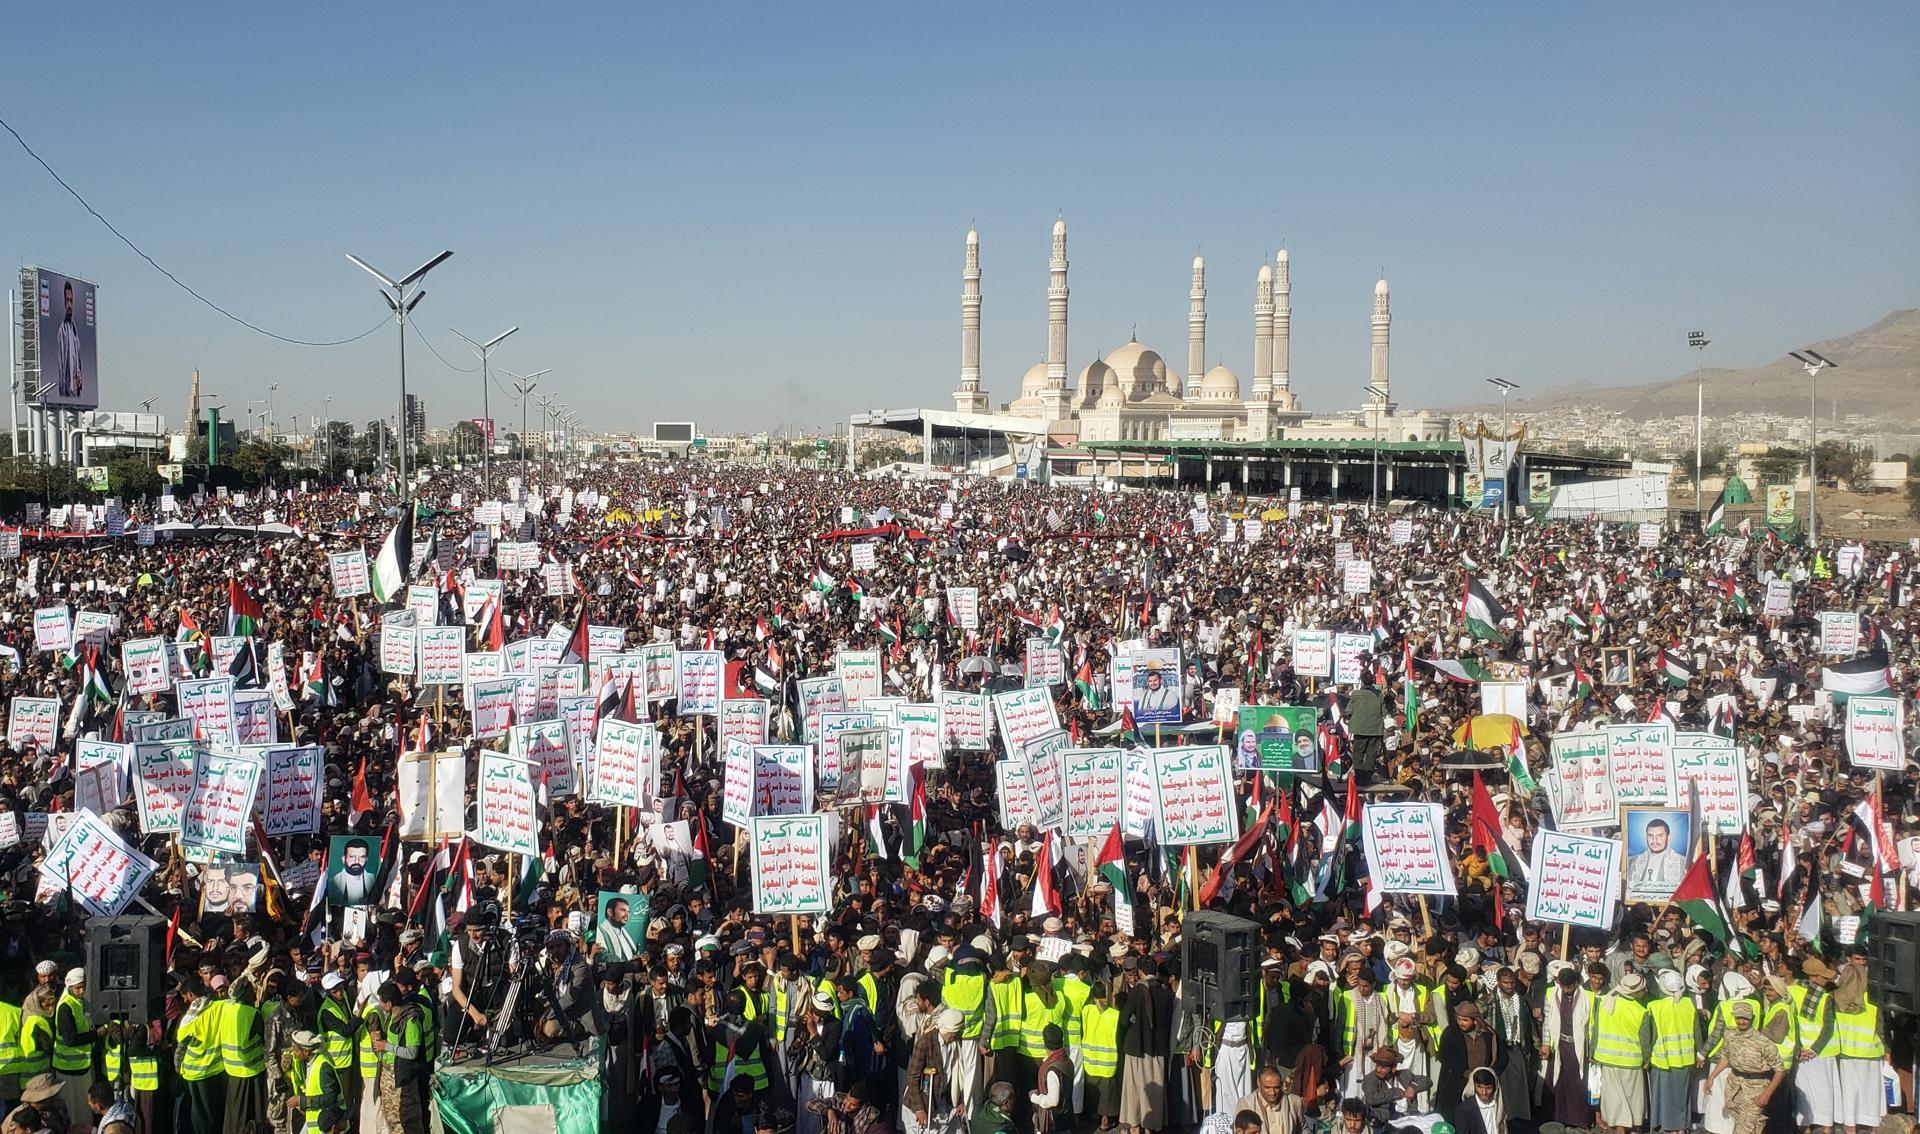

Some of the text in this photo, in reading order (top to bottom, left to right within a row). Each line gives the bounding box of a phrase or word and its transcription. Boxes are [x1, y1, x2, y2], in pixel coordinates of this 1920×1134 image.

[447, 631, 459, 639] الله
[211, 684, 227, 693] الله
[1029, 691, 1044, 702] الله
[749, 705, 763, 714] الله
[852, 719, 869, 728] الله
[548, 725, 564, 737] الله
[1646, 729, 1666, 743] الله
[627, 731, 639, 744] الله
[843, 735, 881, 756] قاطعوا
[786, 752, 802, 763] الله
[1557, 742, 1606, 763] قاطعوا
[298, 754, 316, 767] الله
[1099, 756, 1119, 769] الله
[1197, 753, 1220, 768] الله
[1713, 753, 1735, 766] الله
[1096, 775, 1119, 786] الموت
[1196, 774, 1222, 790] الموت
[1616, 774, 1635, 786] اليهود
[1711, 774, 1735, 783] الموت
[226, 788, 248, 797] الموت
[1097, 789, 1119, 800] الموت
[1198, 791, 1224, 804] الموت
[1712, 788, 1737, 797] الموت
[148, 798, 183, 811] على اليهود
[777, 796, 786, 805] على
[1071, 803, 1119, 817] اللعنة على اليهود
[1704, 802, 1738, 812] اللعنة على
[189, 811, 210, 822] اليهود
[1165, 806, 1226, 823] اللعنة على اليهود
[1408, 810, 1429, 823] الله
[796, 822, 818, 837] الله
[1201, 819, 1228, 838] النصر
[216, 830, 239, 844] النصر
[1407, 830, 1431, 841] الموت
[794, 845, 818, 855] الموت
[1409, 844, 1434, 855] الموت
[1584, 845, 1608, 859] الله
[795, 861, 818, 872] الموت
[1381, 858, 1436, 870] اللعنة على اليهود
[1579, 864, 1605, 875] الموت
[762, 875, 820, 890] اللعنة على اليهود
[1416, 872, 1439, 886] النصر
[1577, 878, 1603, 890] الموت
[797, 889, 822, 907] النصر
[1541, 888, 1601, 904] اللعنة على اليهود
[1572, 906, 1599, 920] النصر
